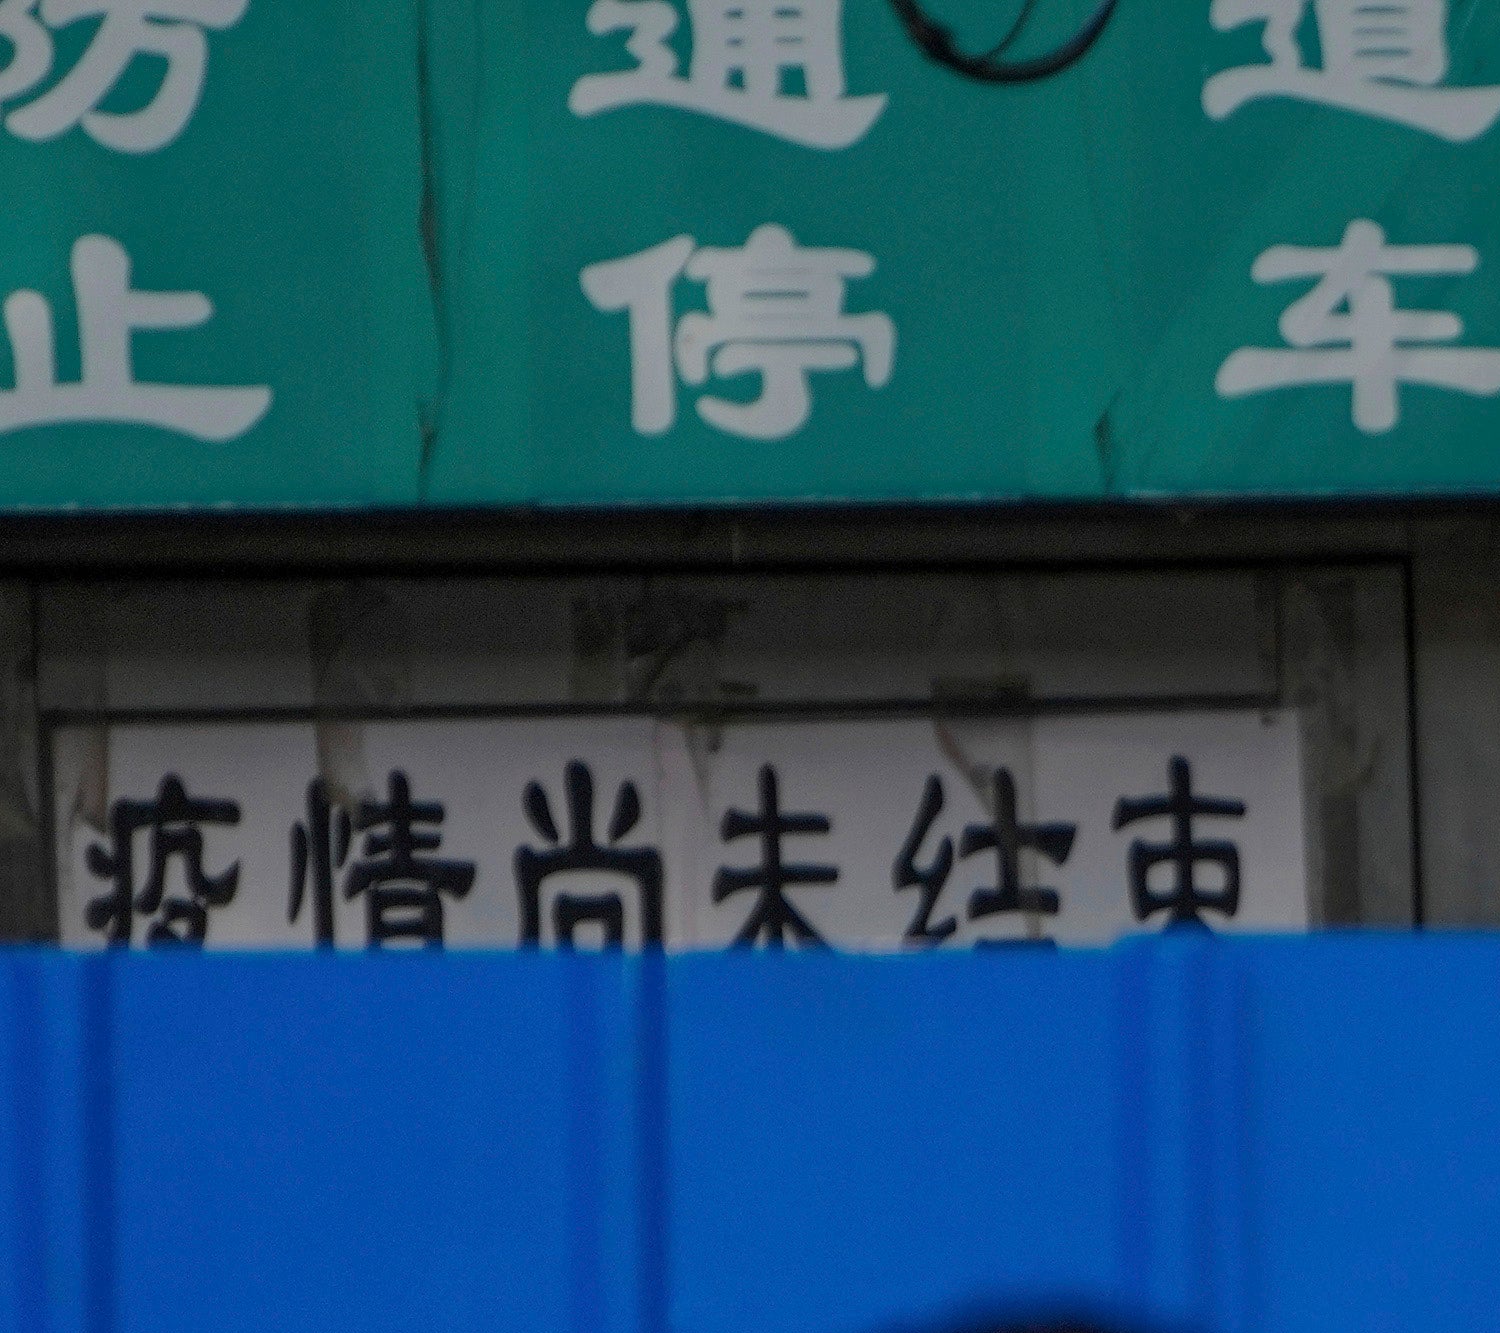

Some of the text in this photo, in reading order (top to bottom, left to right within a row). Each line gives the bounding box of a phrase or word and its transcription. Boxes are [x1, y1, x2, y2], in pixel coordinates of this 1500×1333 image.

[84, 753, 1247, 952] 疫情尚未结束
